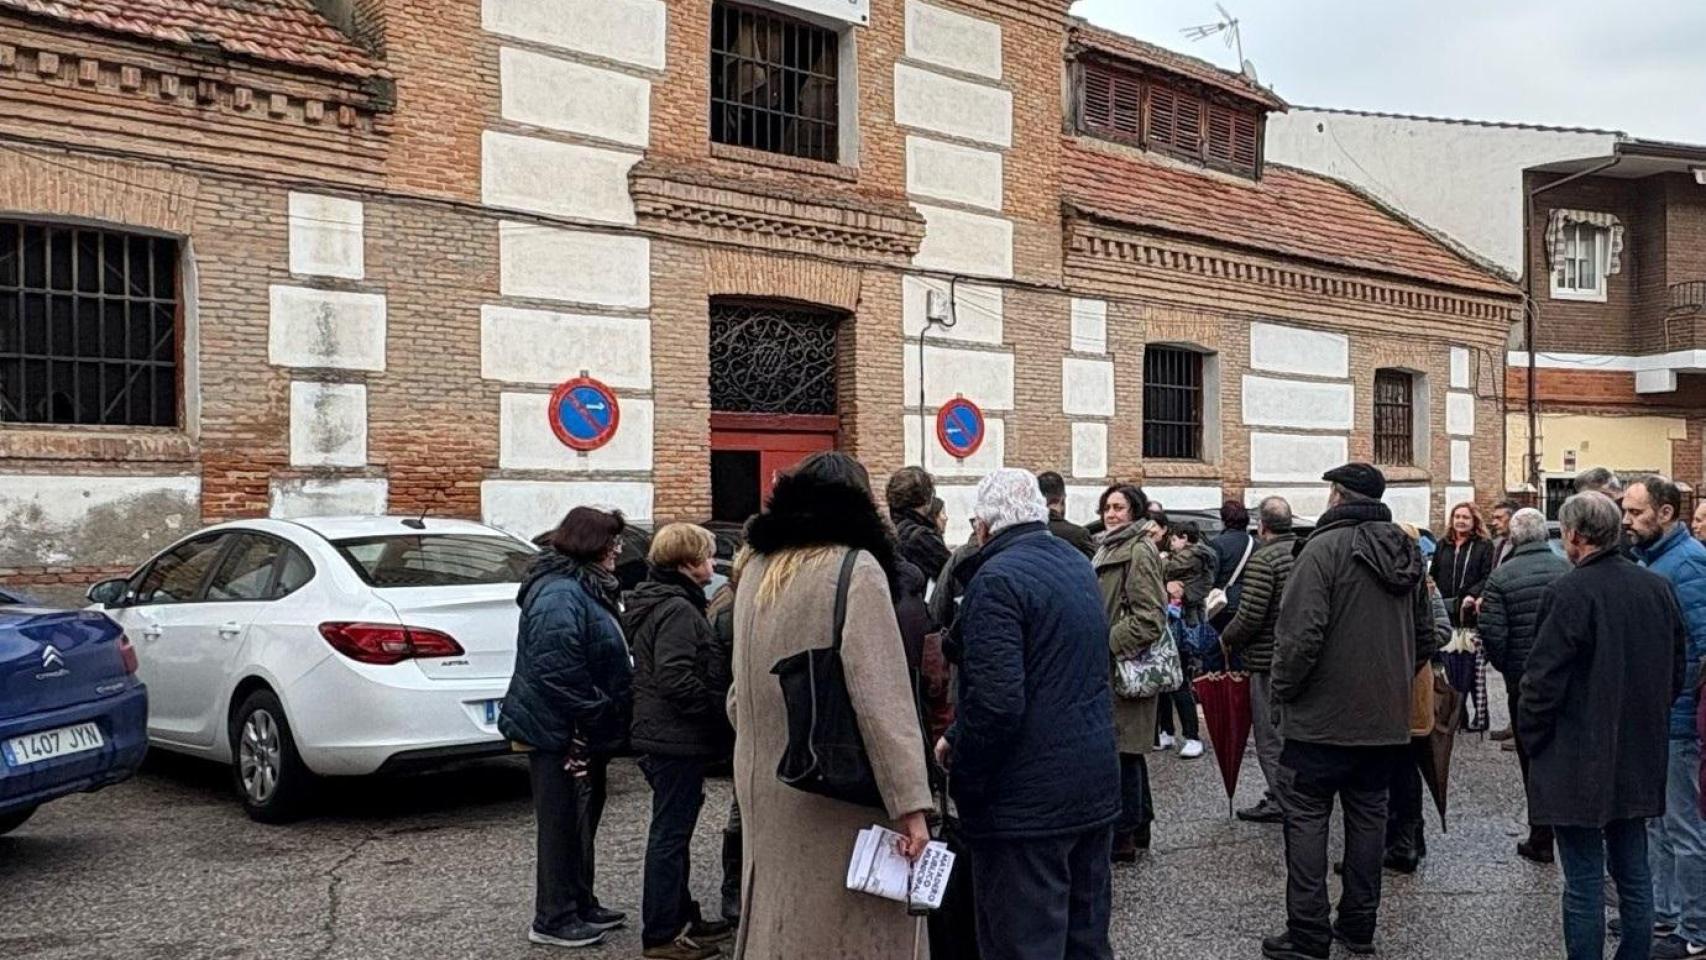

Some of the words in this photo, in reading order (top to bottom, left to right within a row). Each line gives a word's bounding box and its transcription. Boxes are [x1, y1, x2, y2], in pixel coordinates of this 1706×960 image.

[19, 733, 60, 758] 1407
[69, 724, 99, 749] JYN
[927, 852, 949, 902] MATADERO
